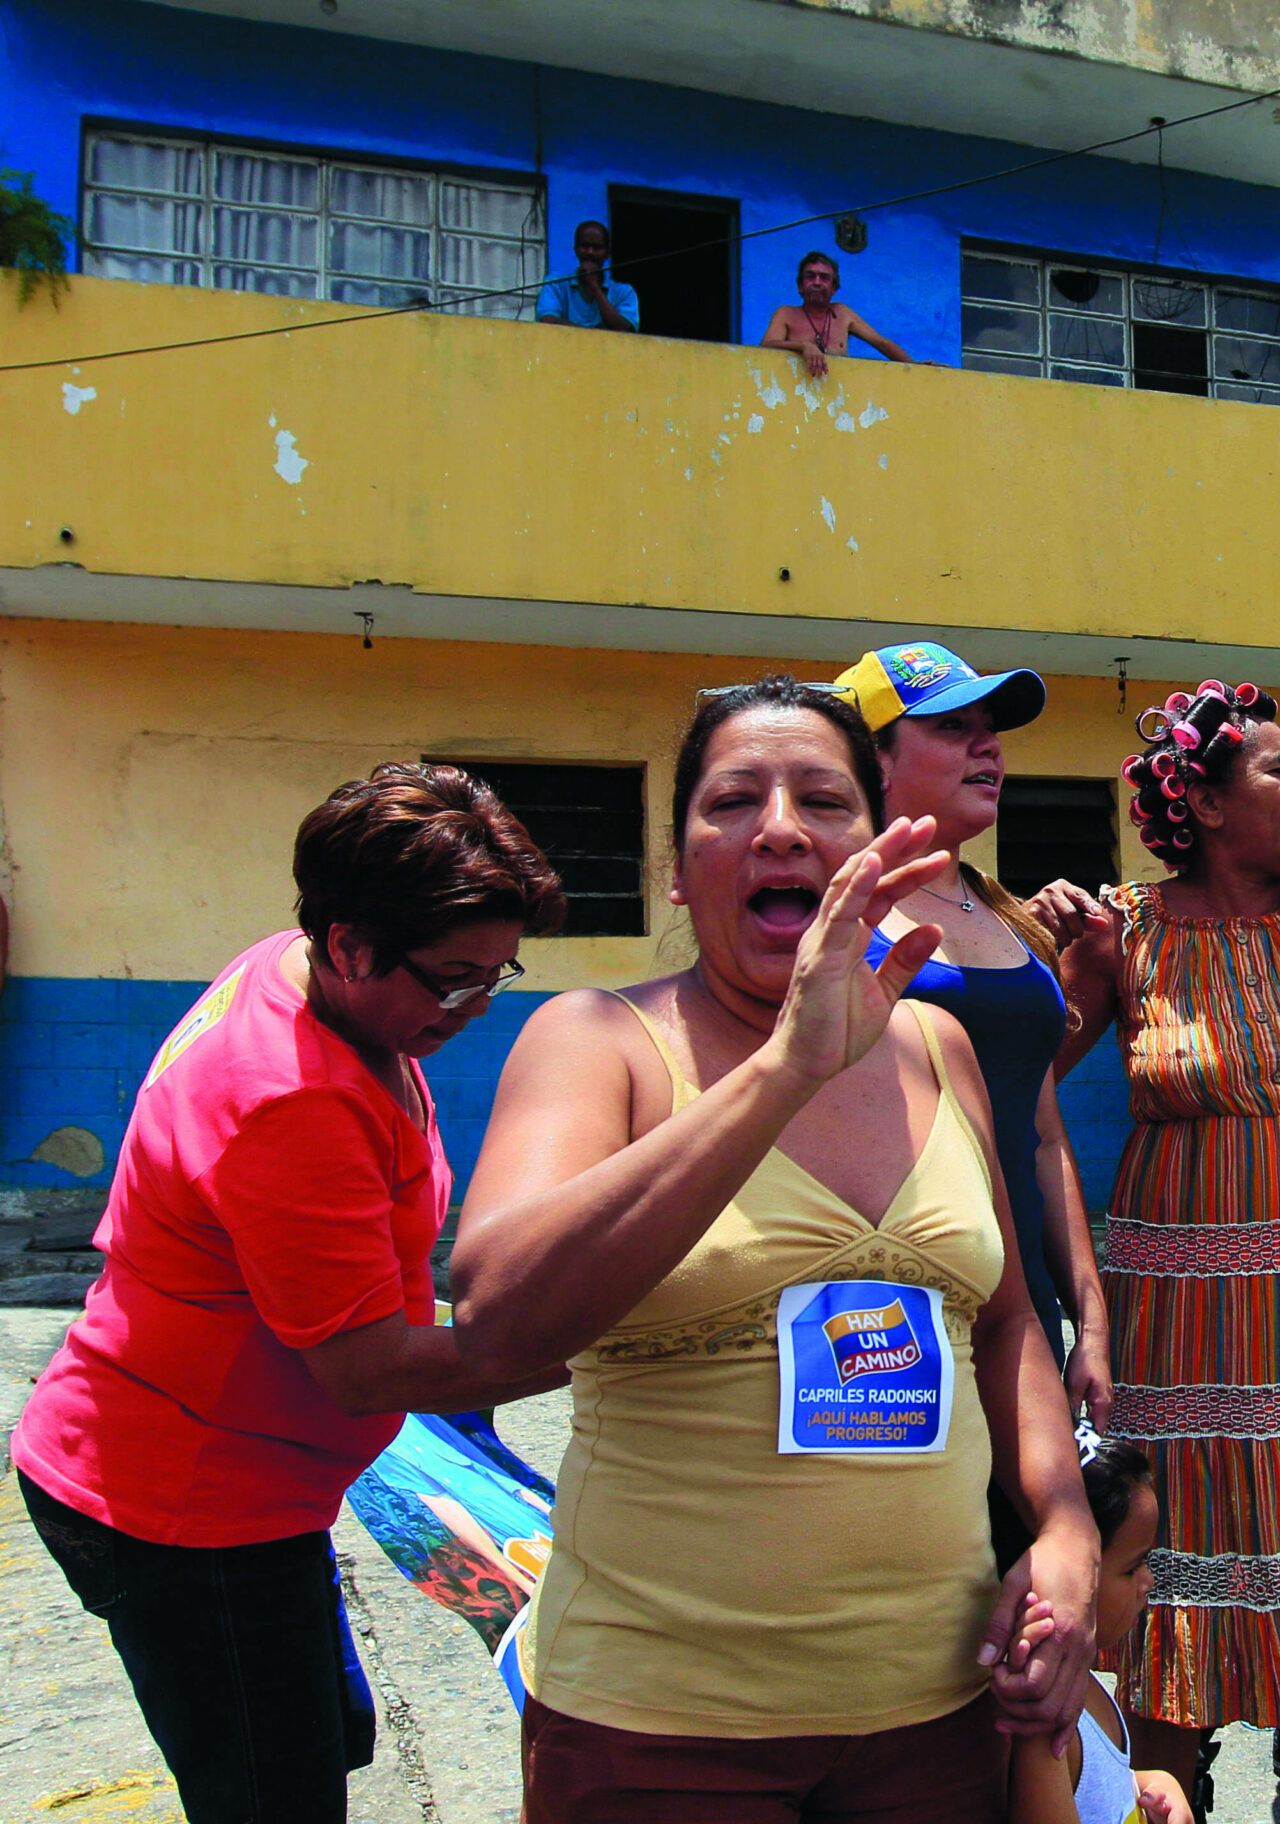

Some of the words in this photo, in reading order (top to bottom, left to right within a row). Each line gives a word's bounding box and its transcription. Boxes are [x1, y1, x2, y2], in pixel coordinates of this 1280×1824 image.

[845, 1311, 885, 1331] HAY
[857, 1332, 889, 1350] UN
[841, 1344, 917, 1378] CAMINO
[798, 1388, 865, 1404] CAPRILES
[868, 1389, 937, 1404] RADONSKI
[806, 1407, 847, 1428] ¡AQUÍ
[850, 1410, 927, 1425] HABLAMOS
[826, 1426, 908, 1441] PROGRESO!
